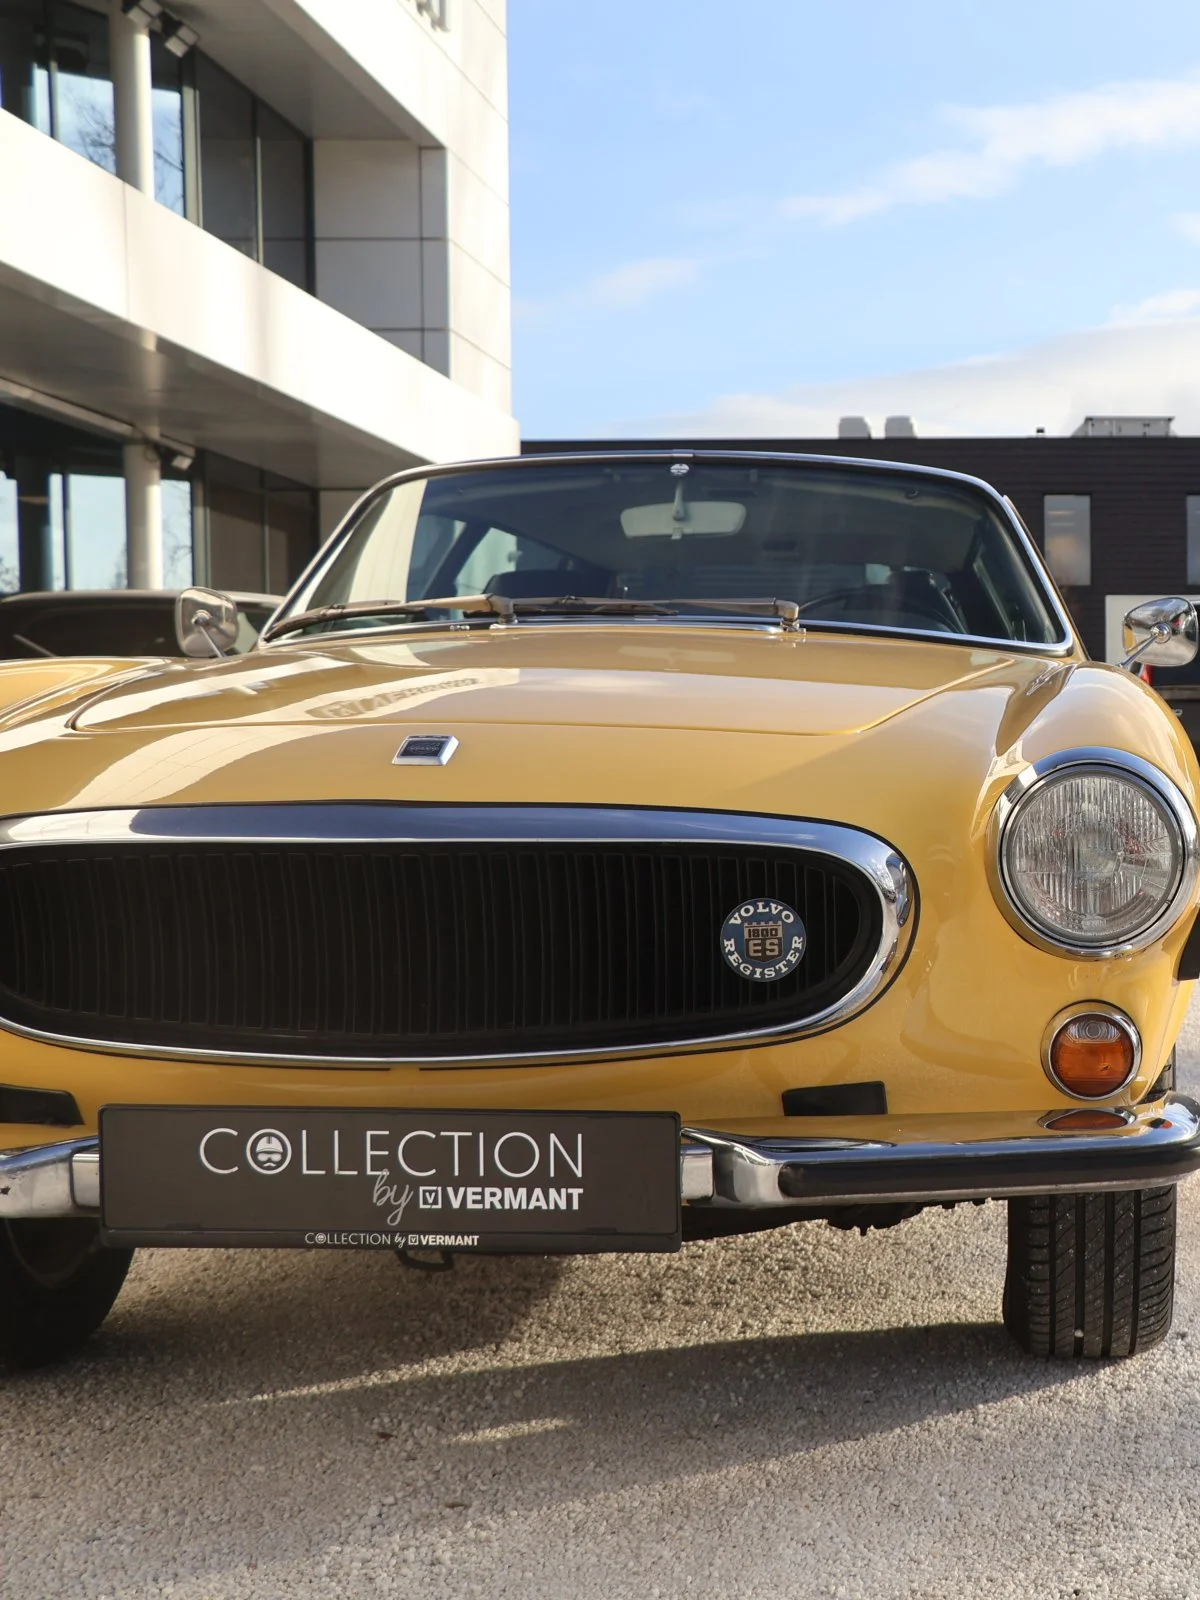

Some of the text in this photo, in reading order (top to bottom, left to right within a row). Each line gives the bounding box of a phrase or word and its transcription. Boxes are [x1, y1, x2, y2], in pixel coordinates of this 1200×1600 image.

[728, 902, 794, 925] VOLVO
[747, 928, 778, 938] 1800
[724, 936, 803, 978] REGISTER
[748, 939, 779, 957] ES
[199, 1127, 583, 1178] COLLECTION
[373, 1168, 414, 1226] by
[446, 1186, 584, 1210] VERMANT
[304, 1232, 391, 1245] COLLECTION
[394, 1232, 407, 1249] by
[420, 1234, 480, 1246] VERMANT
